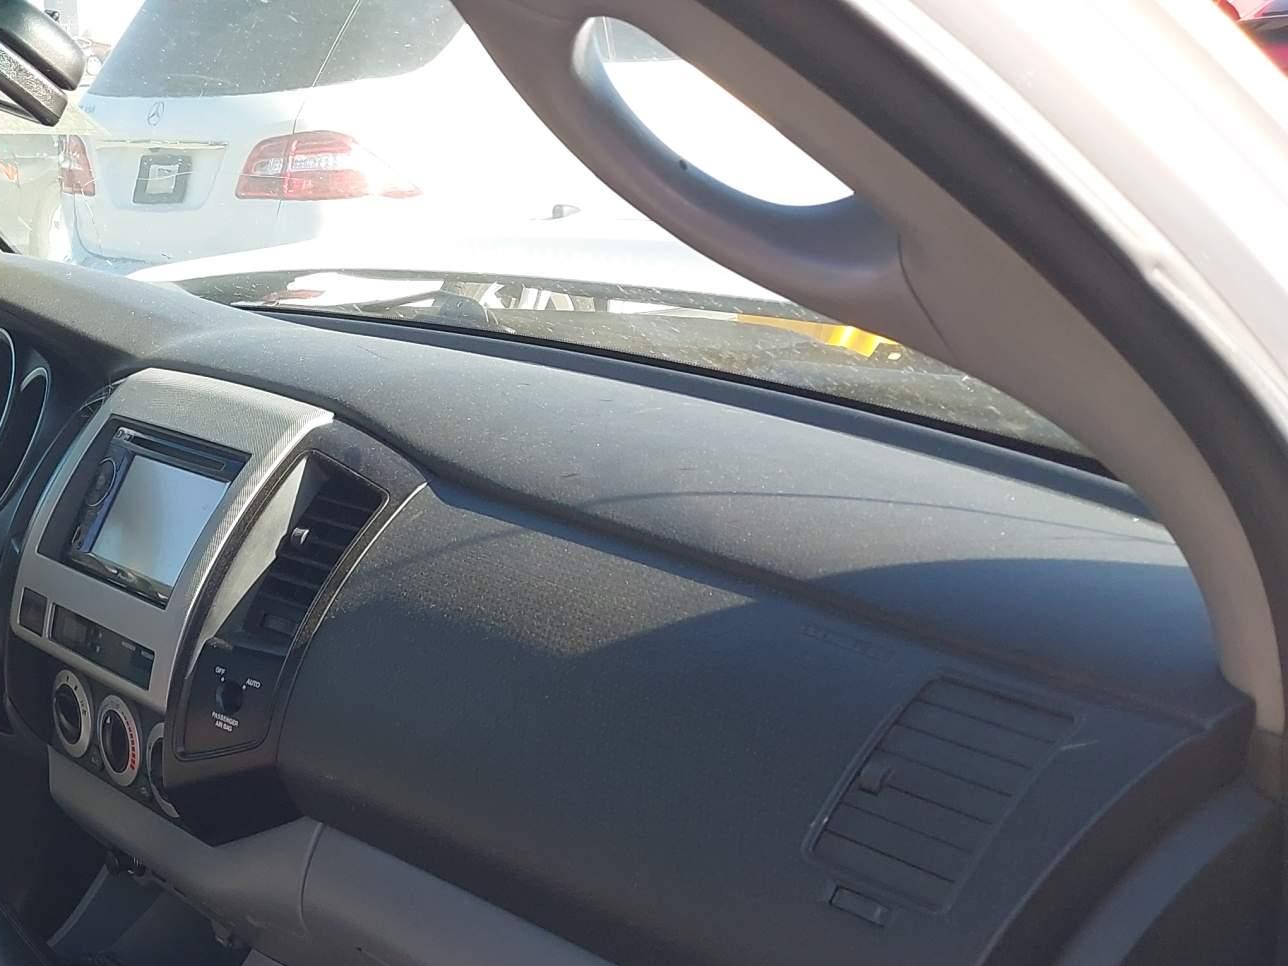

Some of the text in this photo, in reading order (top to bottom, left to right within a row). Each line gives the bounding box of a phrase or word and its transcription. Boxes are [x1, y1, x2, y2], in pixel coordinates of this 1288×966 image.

[215, 666, 226, 675] OFF
[246, 678, 261, 689] AUTO
[212, 711, 239, 727] PASSENGER
[215, 720, 223, 729] AIR
